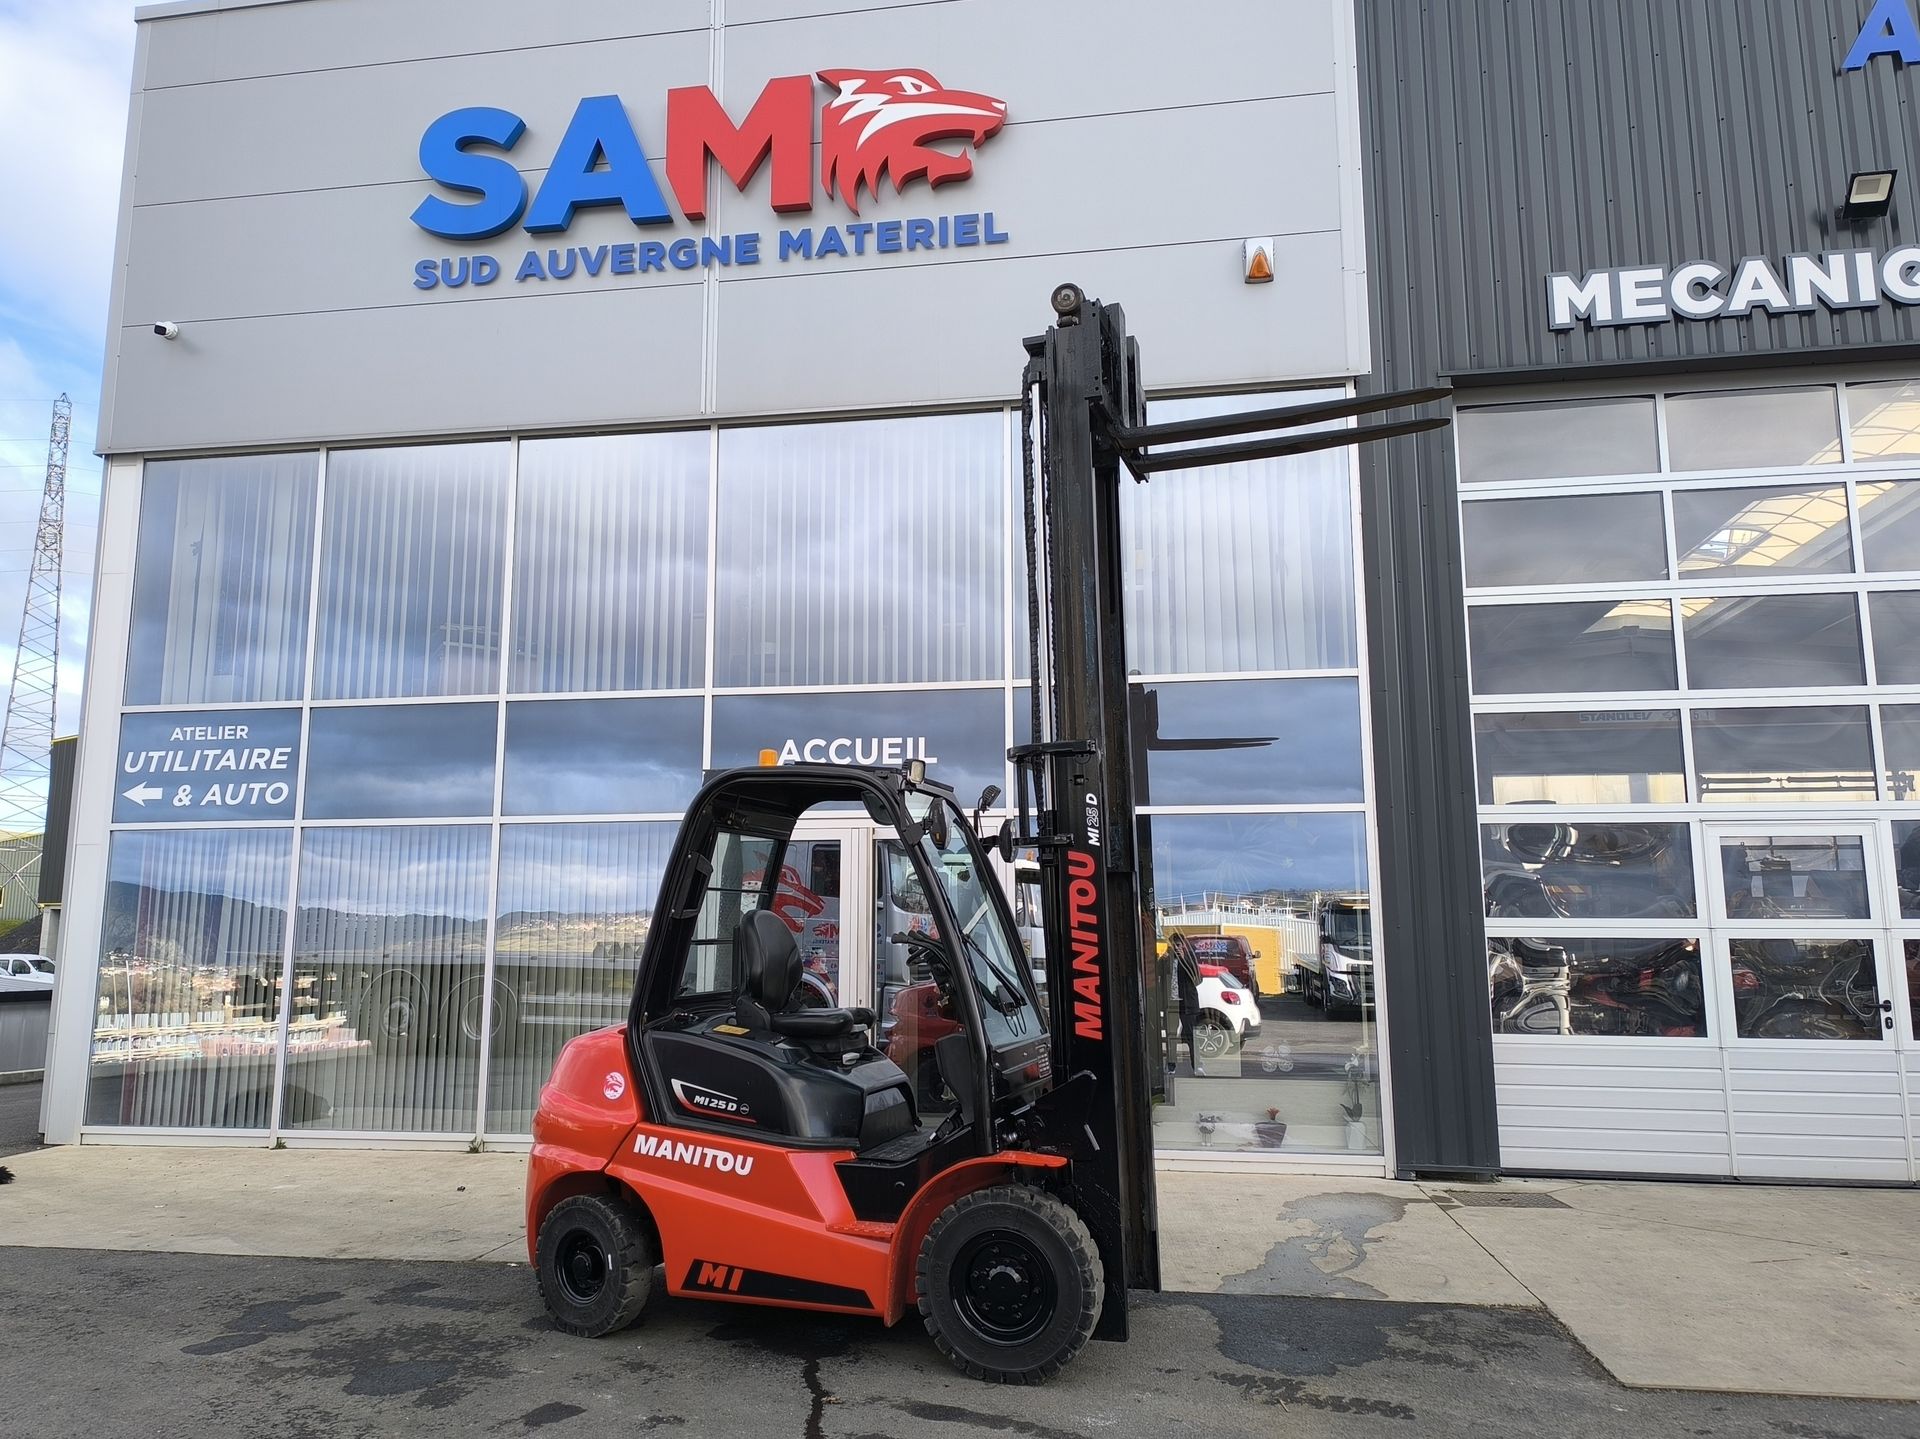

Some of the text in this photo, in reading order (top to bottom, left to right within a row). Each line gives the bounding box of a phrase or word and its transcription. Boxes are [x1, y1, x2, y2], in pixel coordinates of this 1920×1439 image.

[409, 74, 814, 241] SAM
[413, 211, 1010, 290] SUD AUVERGNE MATERIEL
[1550, 246, 1920, 326] MECANIQ
[170, 726, 249, 741] ATELIER
[124, 747, 292, 773] UTILITAIRE
[776, 737, 938, 766] ACCUEIL
[172, 782, 289, 807] & AUTO
[1068, 851, 1103, 1040] MANITOU
[633, 1134, 754, 1176] MANITOU
[697, 1262, 744, 1291] MI
